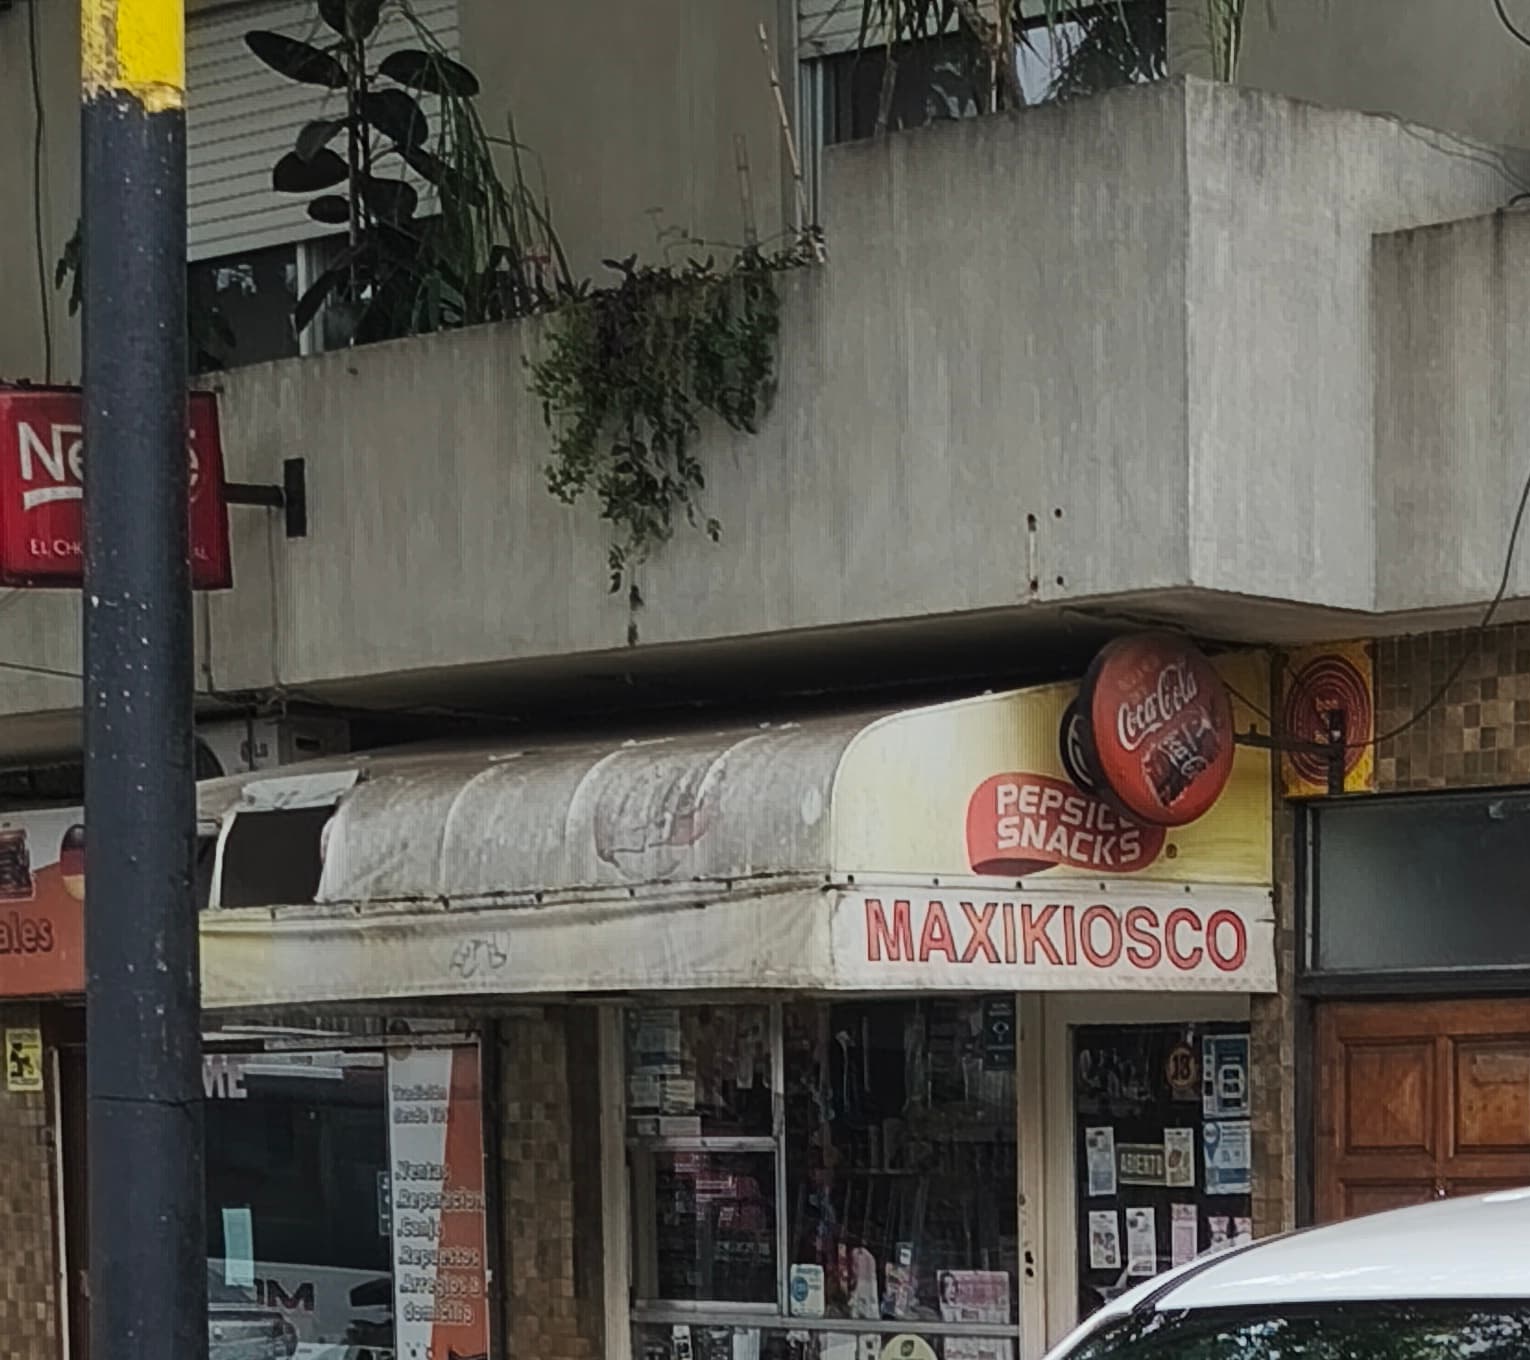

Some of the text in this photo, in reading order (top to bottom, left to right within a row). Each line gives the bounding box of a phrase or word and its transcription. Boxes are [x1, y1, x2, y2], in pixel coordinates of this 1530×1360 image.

[996, 783, 1136, 830] PEPSIC
[997, 815, 1141, 866] SNACKS
[865, 899, 1248, 971] MAXIKIOSCO
